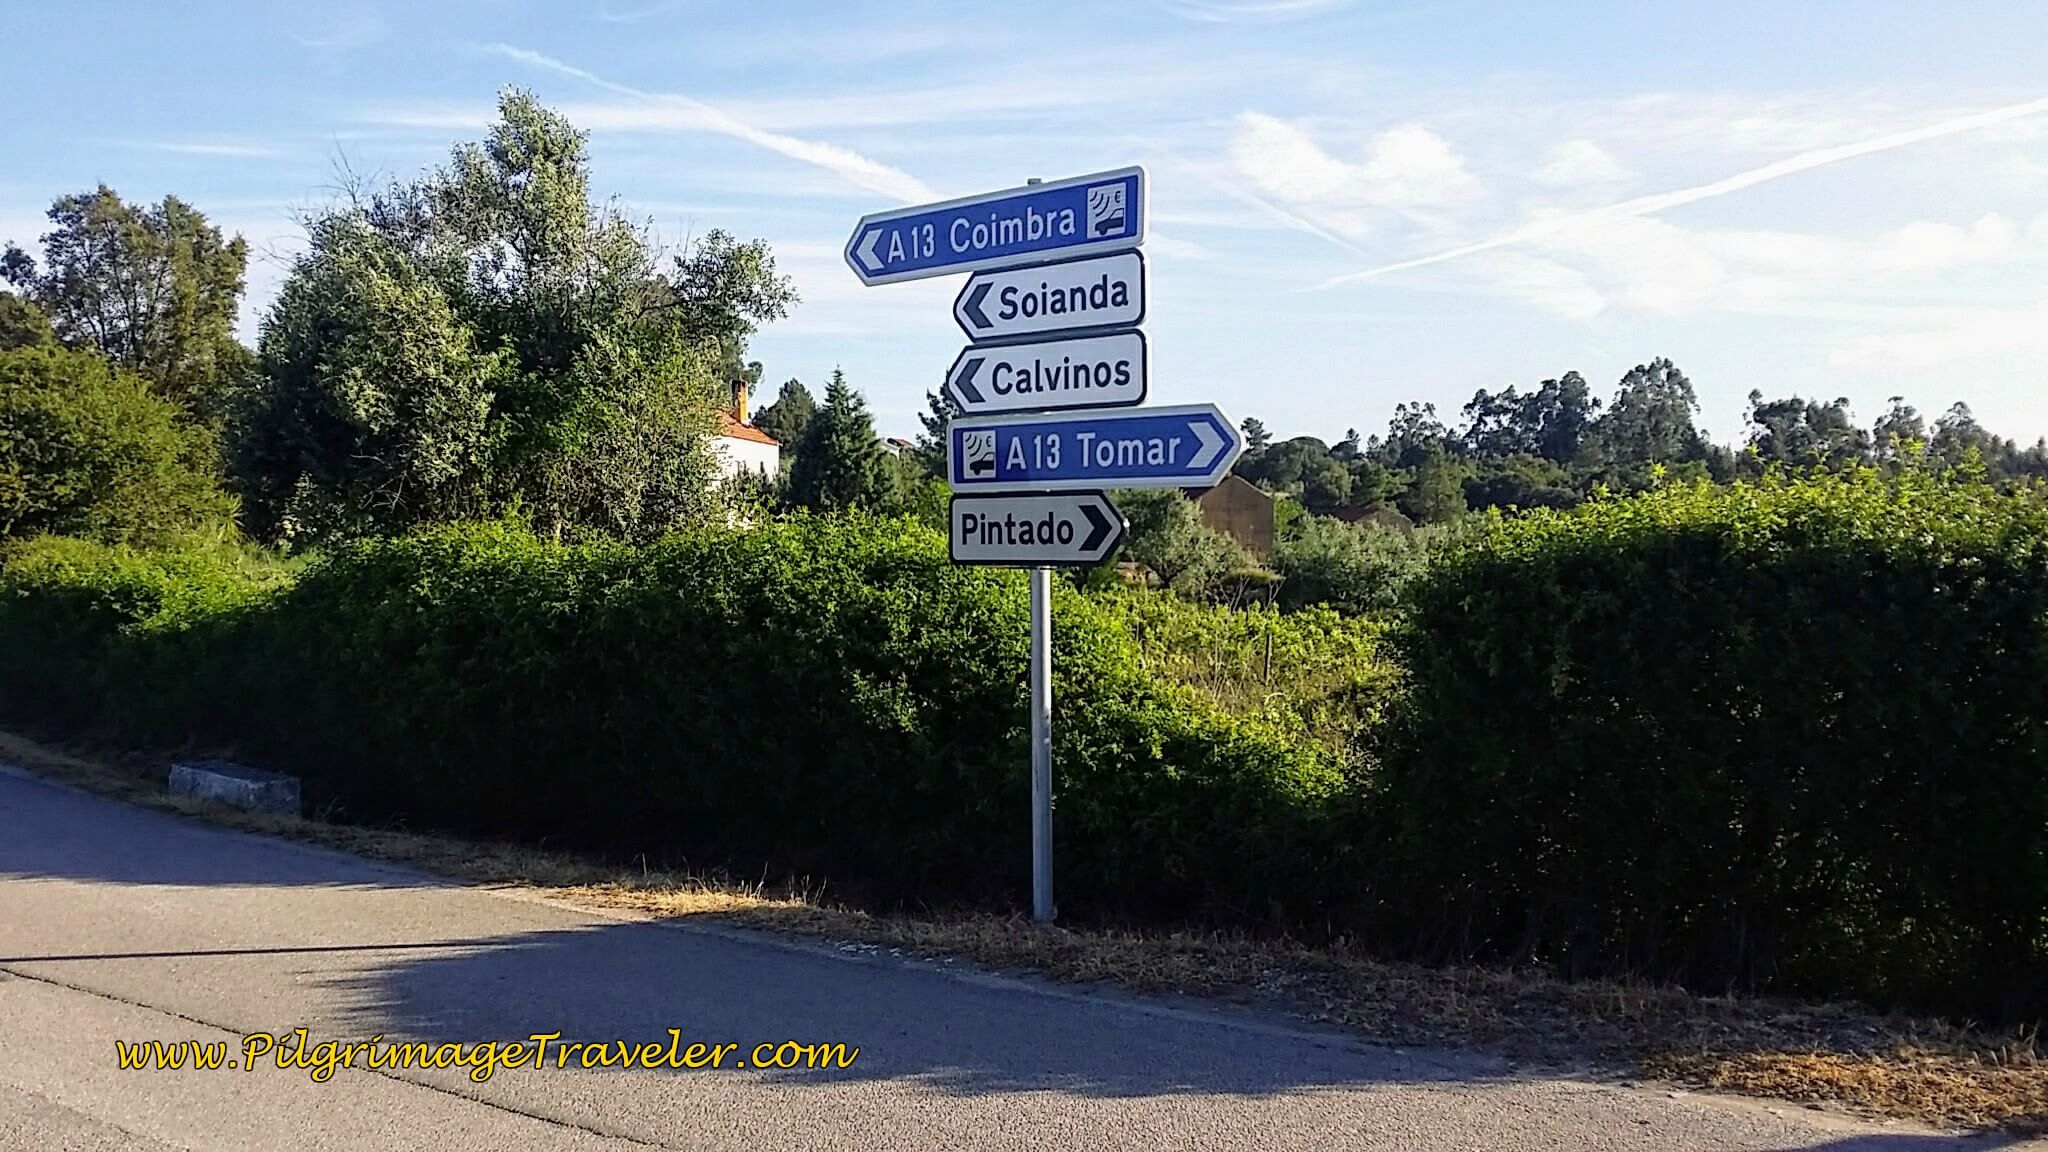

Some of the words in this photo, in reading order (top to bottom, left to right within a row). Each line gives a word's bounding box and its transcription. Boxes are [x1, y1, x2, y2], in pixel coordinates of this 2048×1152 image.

[949, 205, 1076, 253] Coimbra
[998, 274, 1129, 321] Soianda
[991, 356, 1131, 396] Calvinos
[1076, 431, 1182, 468] Tomar
[961, 511, 1074, 546] Pintado
